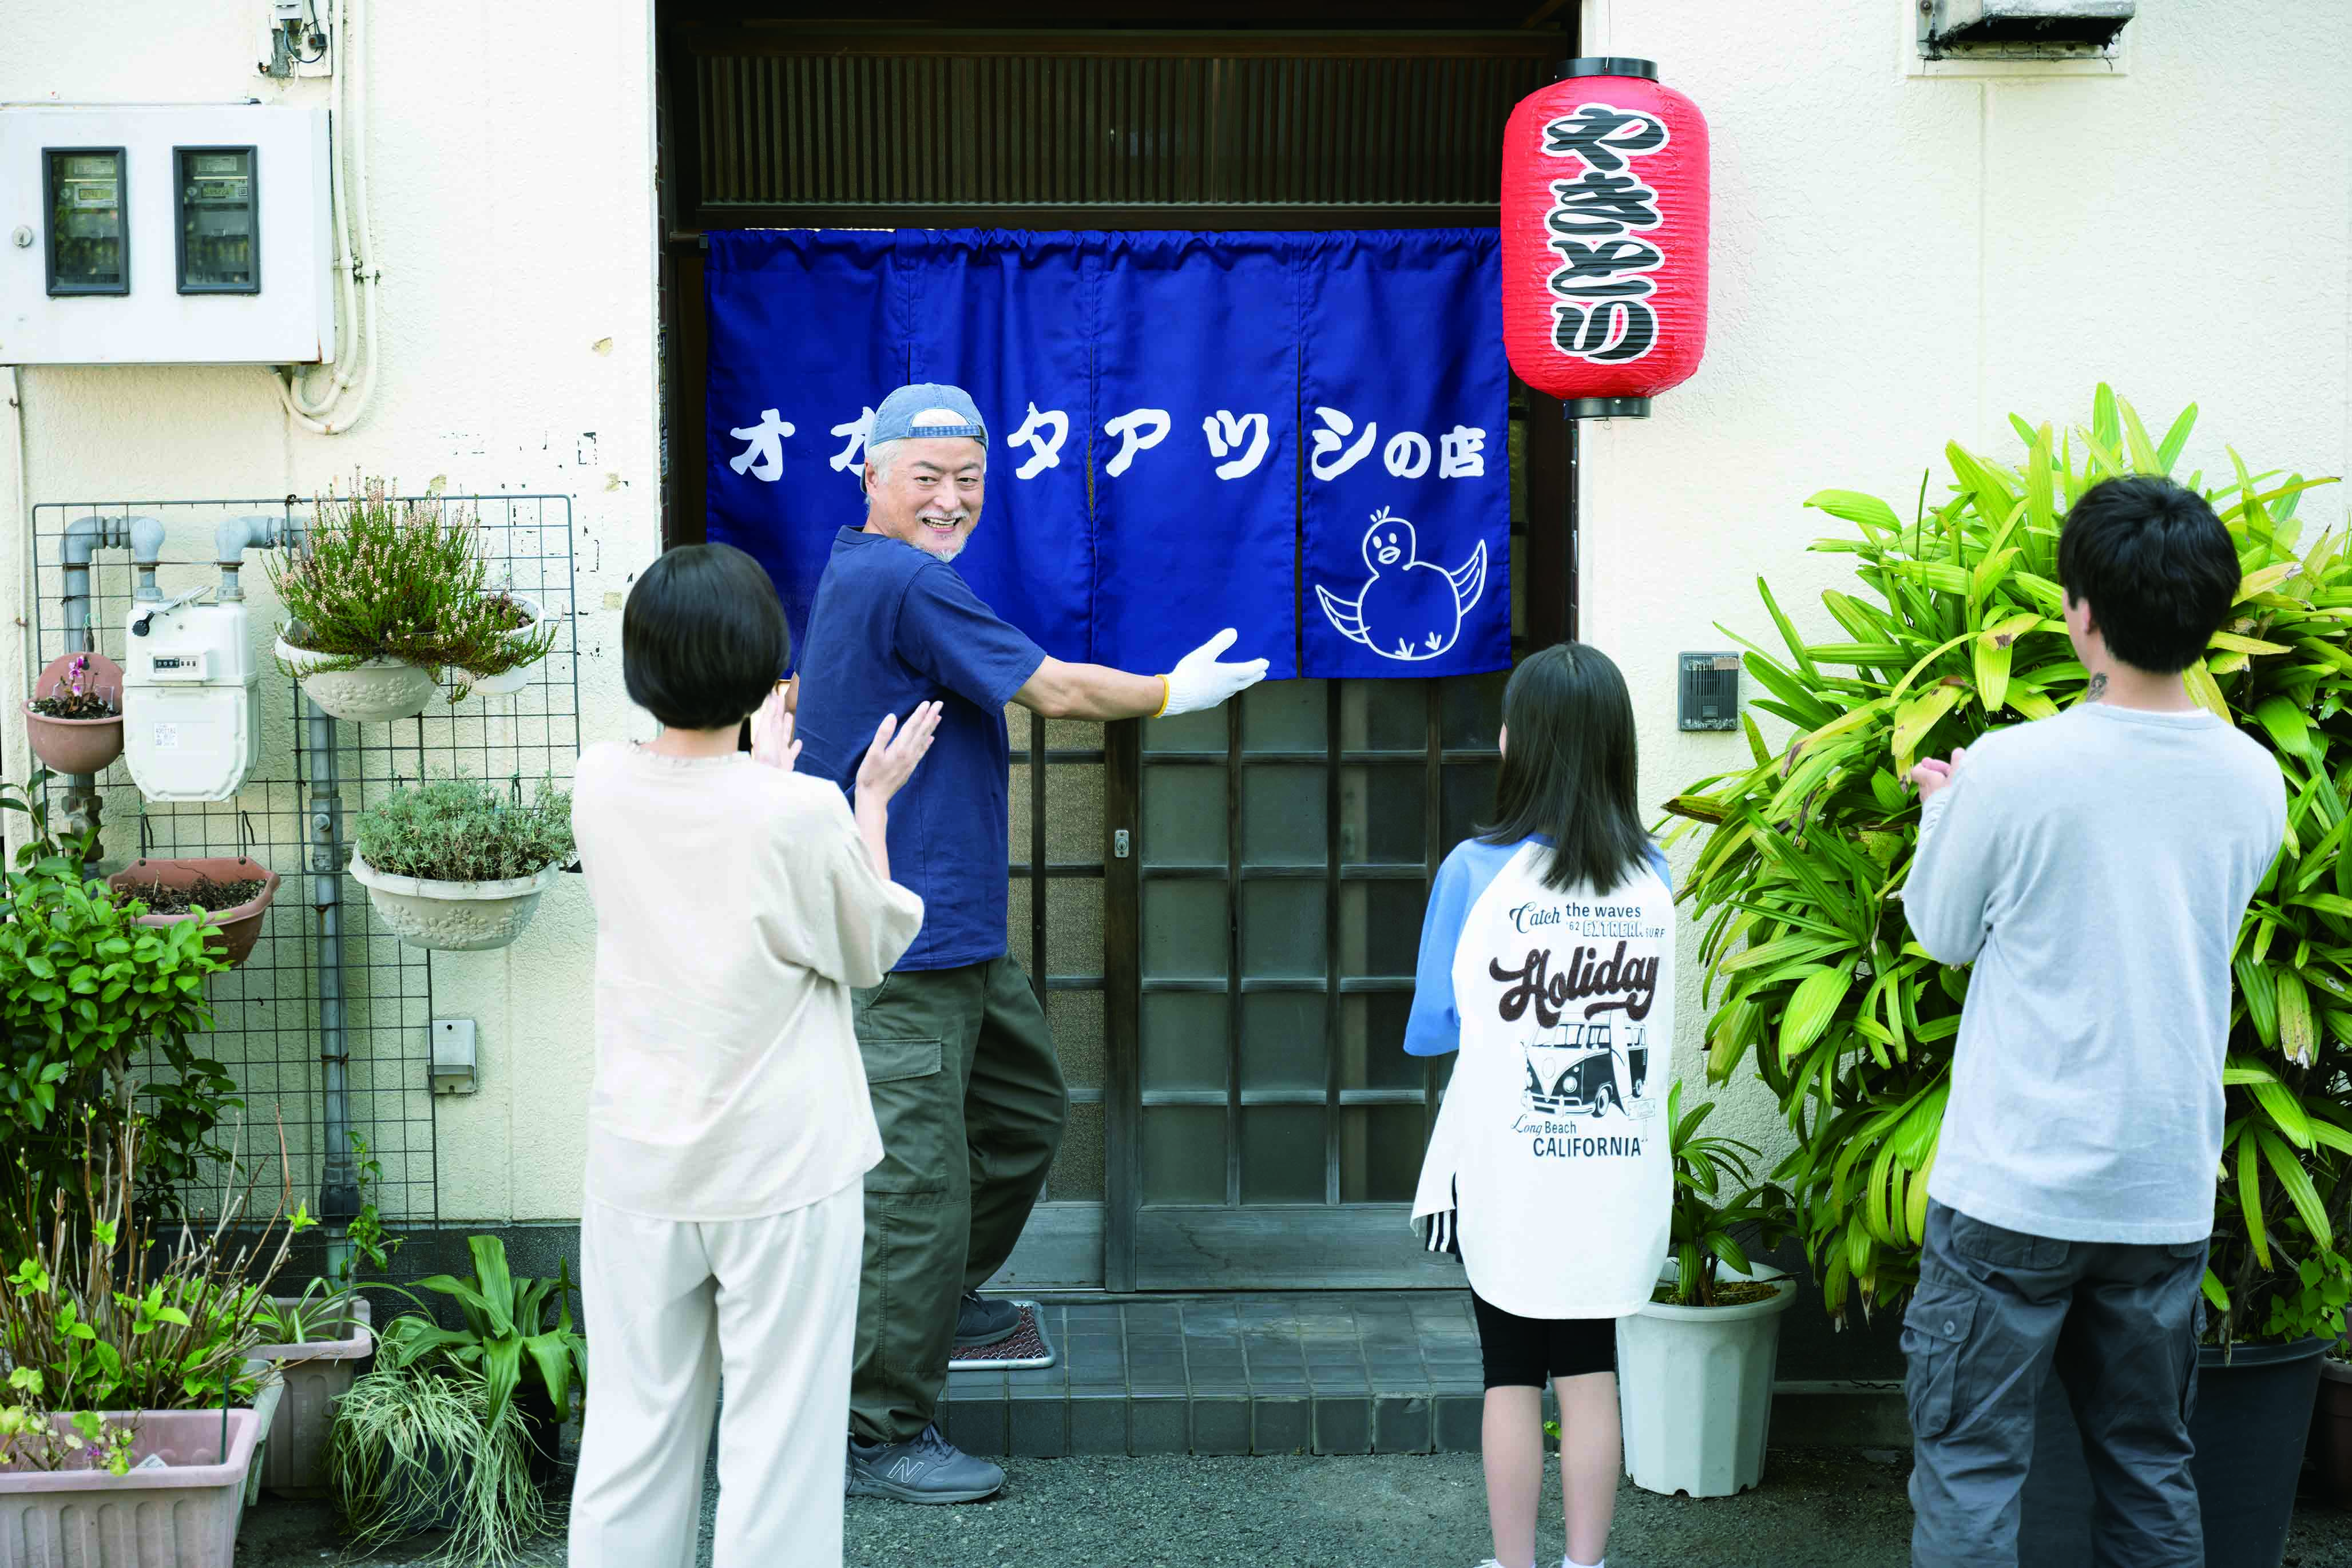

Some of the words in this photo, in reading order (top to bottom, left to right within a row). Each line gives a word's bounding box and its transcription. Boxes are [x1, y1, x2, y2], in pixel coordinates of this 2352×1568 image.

[1541, 104, 1669, 364] やきとり
[1509, 901, 1561, 934] Catch
[1566, 902, 1589, 917] the
[1595, 906, 1641, 918] waves
[1645, 927, 1665, 938] SURF
[1489, 940, 1660, 1029] Holiday
[1510, 1113, 1542, 1136] Long
[1545, 1121, 1576, 1134] Beach
[1533, 1137, 1641, 1157] CALIFORNIA
